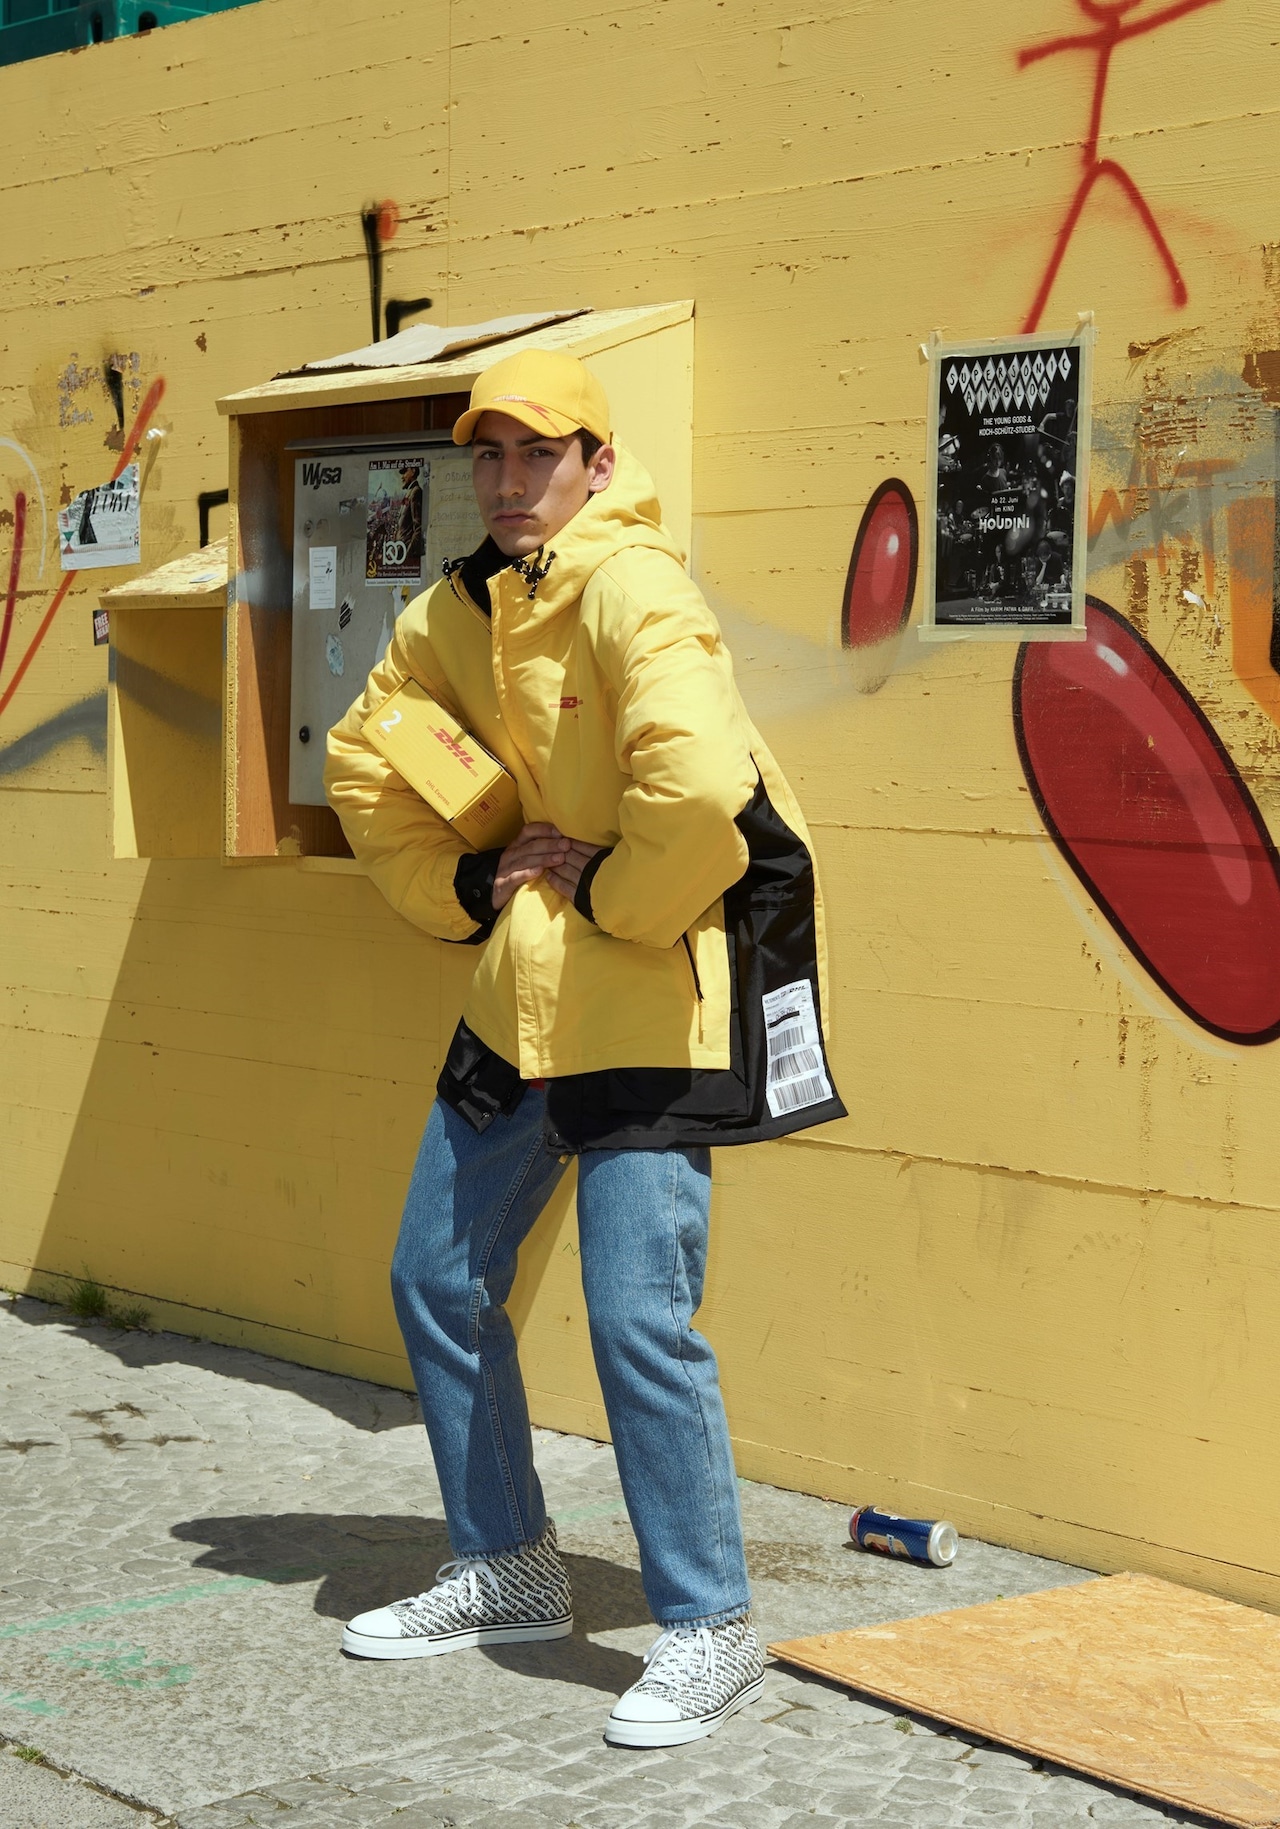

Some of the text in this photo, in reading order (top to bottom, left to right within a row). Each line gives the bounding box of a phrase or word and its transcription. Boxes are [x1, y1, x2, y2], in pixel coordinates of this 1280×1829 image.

[948, 354, 1069, 388] SUPERSONIC
[965, 382, 1048, 406] AIRGLOW
[983, 417, 994, 425] THE
[994, 416, 1011, 425] YOUNG
[1012, 416, 1027, 424] GODS
[302, 463, 342, 490] Wysa
[979, 512, 1030, 533] HOUDINI
[94, 612, 108, 631] FREE
[380, 710, 402, 733] 2
[434, 728, 475, 770] DHL
[425, 779, 451, 807] DHL Express
[501, 1574, 526, 1596] VETEMENTS
